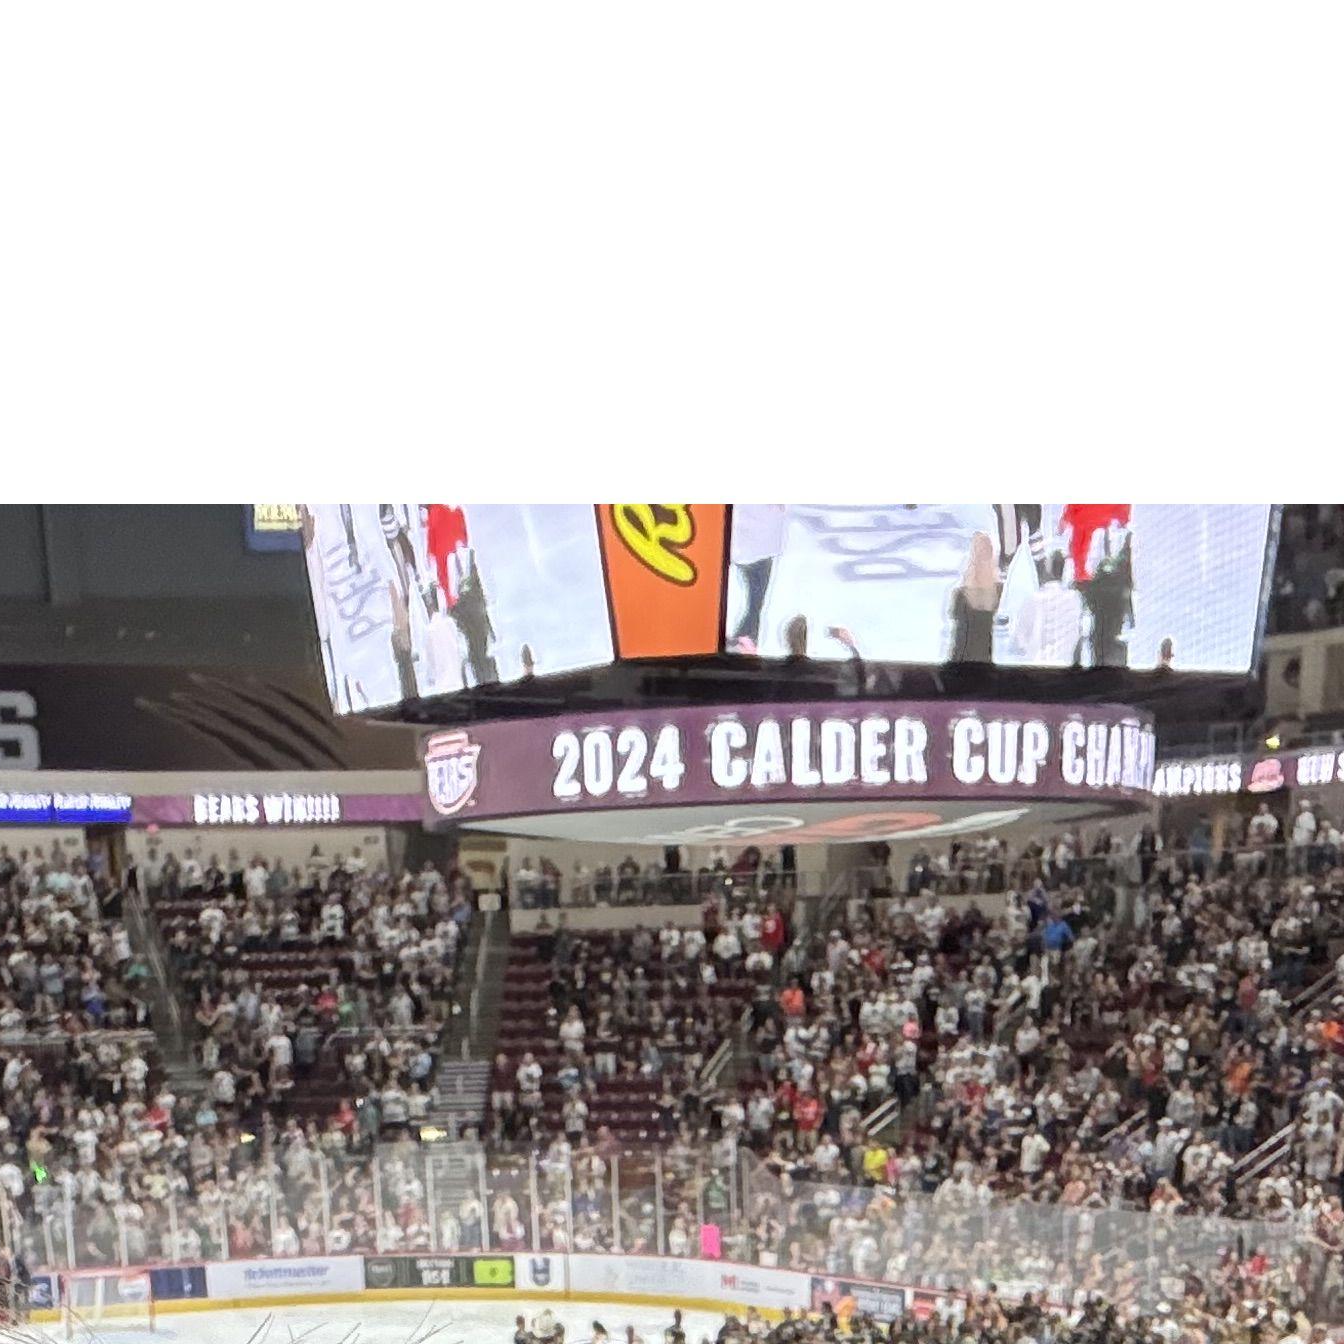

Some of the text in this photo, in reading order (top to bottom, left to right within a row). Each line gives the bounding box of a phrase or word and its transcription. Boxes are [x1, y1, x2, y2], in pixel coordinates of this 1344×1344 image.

[552, 723, 685, 798] 2024
[710, 716, 929, 788] CALDER
[951, 715, 1050, 786] CUP
[193, 793, 260, 825] BEARS
